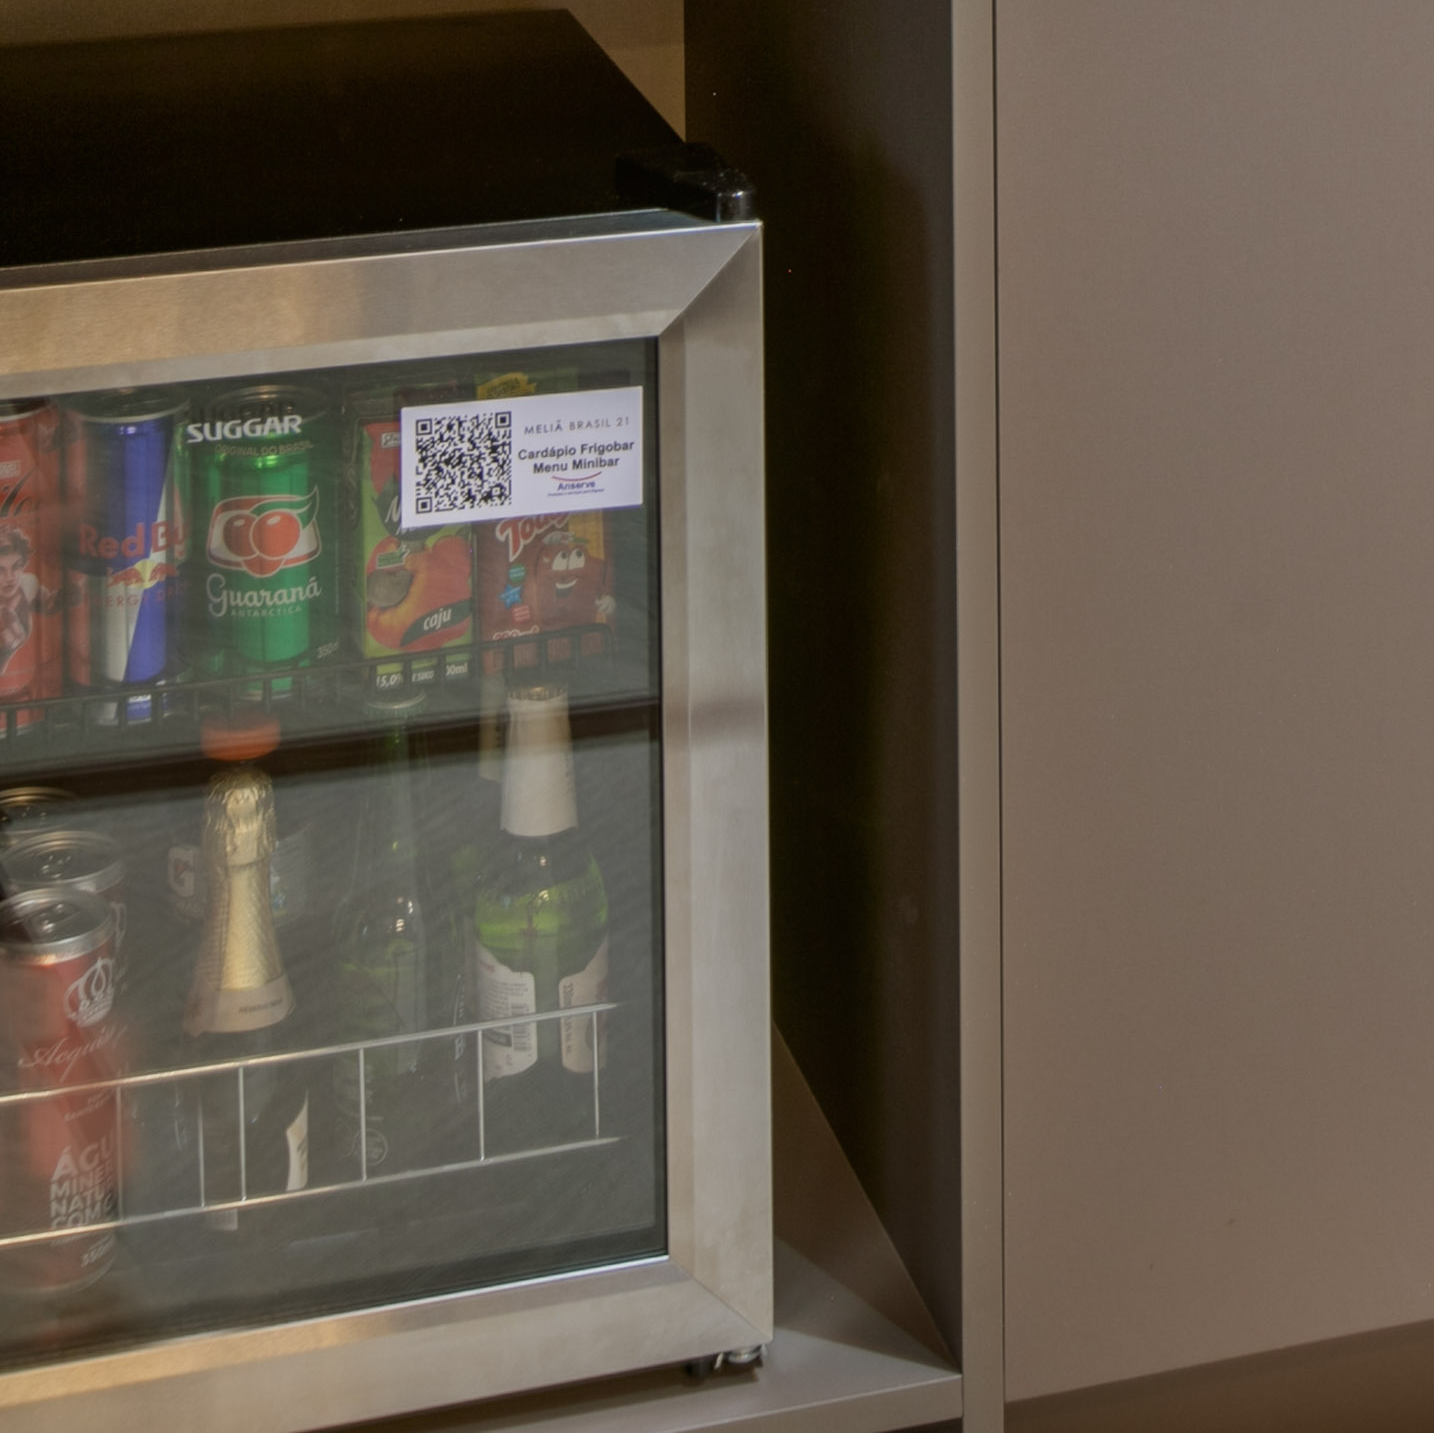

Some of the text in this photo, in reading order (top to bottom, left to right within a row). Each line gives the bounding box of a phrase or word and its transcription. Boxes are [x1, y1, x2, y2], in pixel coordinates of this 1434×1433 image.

[187, 414, 303, 444] SUGGAR
[569, 418, 611, 431] BRASIL
[616, 416, 629, 427] 21
[517, 440, 635, 460] Cardápio Frigobar
[533, 456, 620, 474] Menu Minibar
[79, 521, 146, 559] Red
[206, 573, 322, 617] Guaraná
[230, 606, 301, 618] ANTARCTICA
[423, 608, 452, 630] caju
[51, 1134, 114, 1183] ÁGU
